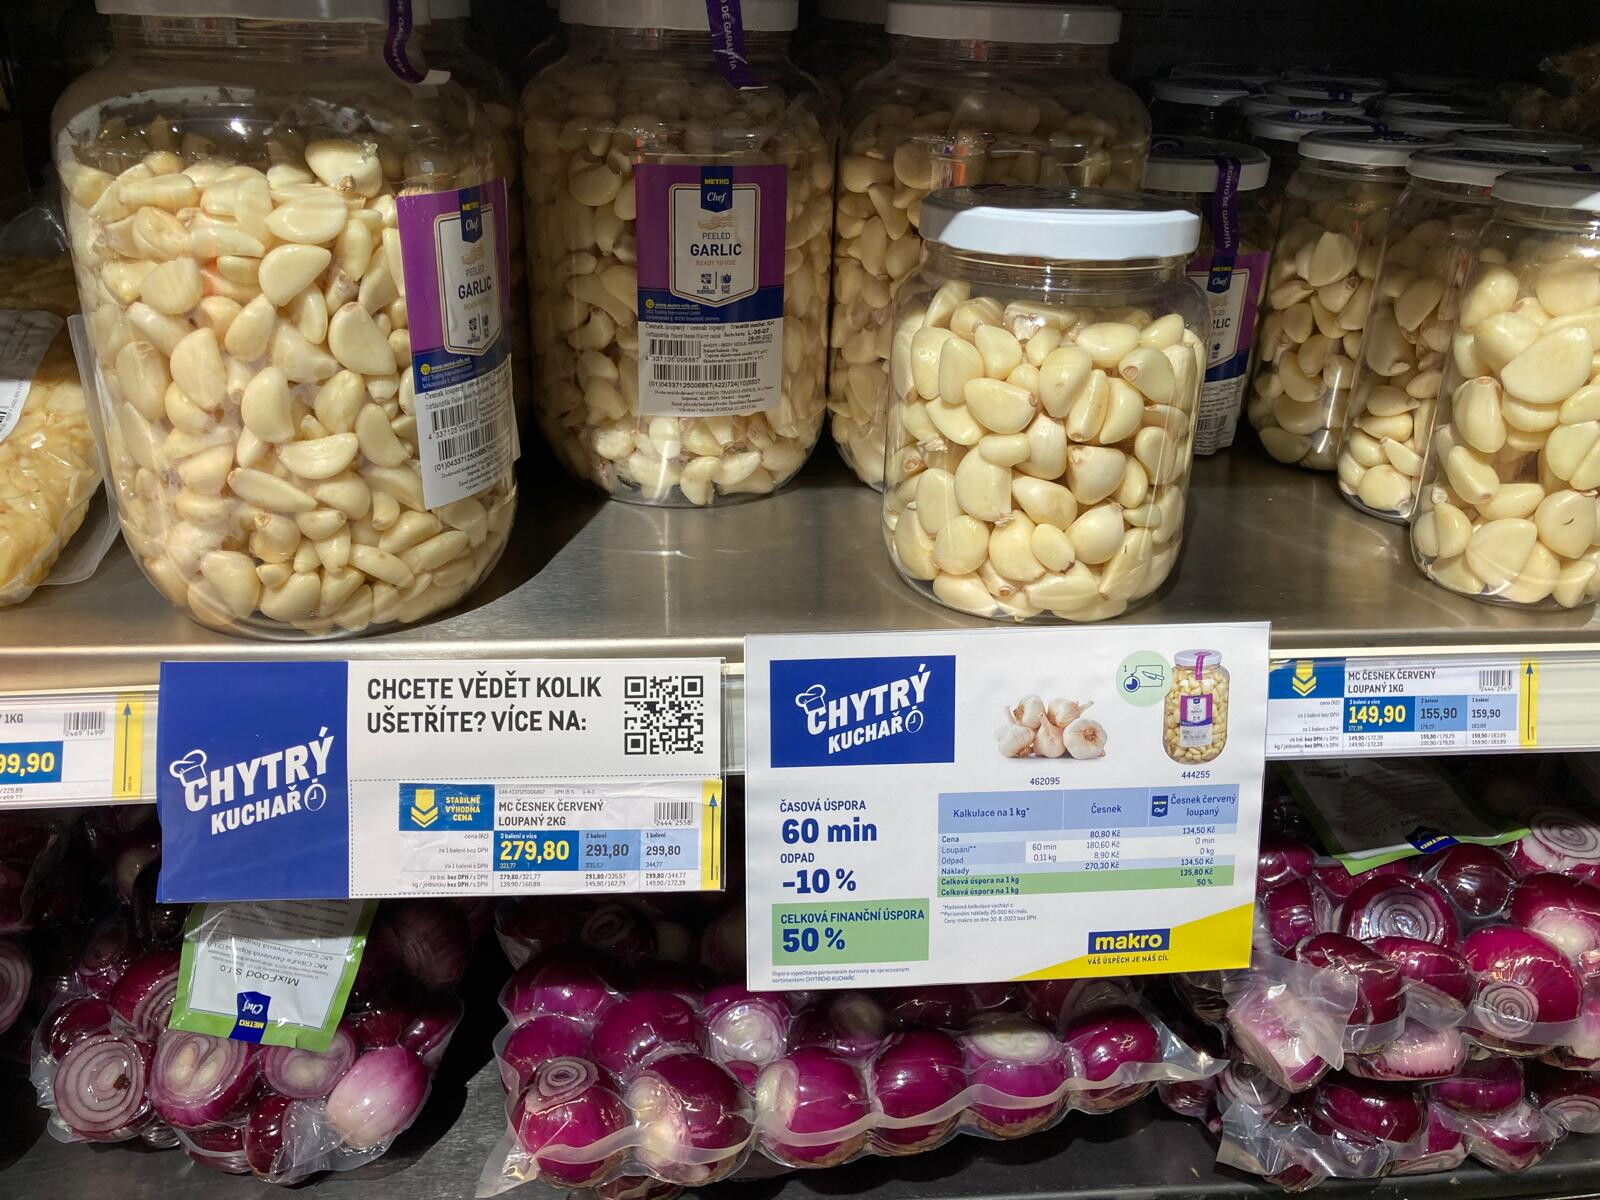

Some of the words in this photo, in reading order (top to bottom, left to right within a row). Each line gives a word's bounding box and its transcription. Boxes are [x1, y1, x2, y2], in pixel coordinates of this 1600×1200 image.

[707, 192, 727, 204] Chef
[690, 244, 742, 256] GARLIC
[458, 276, 491, 299] GARLIC
[1348, 671, 1361, 681] MC
[1362, 668, 1395, 680] ČESNEK
[1397, 668, 1436, 680] ČERVENÝ
[367, 678, 454, 700] CHCETE
[458, 670, 531, 699] VĚDĚT
[536, 676, 602, 698] KOLIK
[1348, 682, 1387, 693] LOUPANÝ
[1389, 684, 1404, 693] 1KG
[807, 663, 931, 735] CHYTRÝ
[5, 713, 23, 724] 1KG
[367, 704, 487, 734] UŠETŘÍTE?
[490, 703, 542, 732] VÍCE
[549, 710, 587, 732] NA:
[1349, 705, 1406, 726] 149,90
[1420, 707, 1458, 720] 155,90
[1472, 709, 1501, 719] 159,90
[828, 711, 903, 754] KUCHAŘ
[184, 726, 334, 812] CHYTRÝ
[1181, 771, 1210, 779] 444255
[1029, 777, 1060, 786] 462095
[446, 794, 481, 804] STABILNĚ
[499, 802, 513, 812] MC
[515, 798, 556, 811] ČESNEK
[557, 798, 604, 811] ČERVENÝ
[780, 798, 822, 813] ČASOVÁ
[824, 797, 866, 811] ÚSPORA
[1171, 794, 1200, 805] Česnek
[1202, 794, 1236, 804] červený
[211, 784, 302, 835] KUCHAŘ
[445, 803, 481, 813] VÝHODNÁ
[953, 809, 995, 818] Kalkulace
[997, 809, 1008, 817] na
[1009, 808, 1014, 816] 1
[1091, 802, 1122, 814] Česnek
[1186, 807, 1220, 817] loupaný
[498, 813, 545, 826] LOUPANÝ
[547, 816, 566, 826] 2KG
[782, 818, 819, 844] 60
[827, 816, 877, 842] min
[941, 835, 959, 843] Cena
[1090, 830, 1111, 838] 80,80
[1183, 827, 1206, 835] 134,50
[1207, 826, 1216, 834] Kč
[500, 840, 570, 864] 279,80
[586, 844, 629, 859] 291,80
[646, 845, 681, 857] 299,80
[1032, 843, 1042, 851] 60
[1087, 841, 1110, 849] 180,60
[1111, 840, 1120, 848] Kč
[780, 853, 815, 863] ODPAD
[941, 857, 964, 865] Odpad
[1033, 854, 1047, 862] 0,11
[1048, 854, 1057, 862] kg
[1111, 851, 1120, 859] Kč
[1206, 847, 1214, 856] kg
[941, 867, 970, 876] Náklady
[1085, 862, 1109, 870] 270,30
[1111, 861, 1120, 869] Kč
[1181, 858, 1204, 866] 134,50
[835, 868, 856, 891] %
[941, 877, 969, 886] Celková
[970, 877, 994, 886] úspora
[1011, 876, 1019, 885] kg
[1180, 869, 1203, 877] 135,80
[1205, 868, 1213, 876] Kč
[941, 888, 969, 896] Celková
[970, 888, 994, 896] úspora
[1011, 887, 1019, 895] kg
[781, 909, 828, 924] CELKOVÁ
[830, 908, 881, 922] FINANČNÍ
[883, 907, 925, 921] ÚSPORA
[783, 927, 819, 952] 50
[824, 927, 846, 950] %
[1095, 932, 1163, 950] makro
[1088, 956, 1101, 965] VÁŠ
[1103, 955, 1130, 964] ÚSPĚCH
[1142, 954, 1156, 962] NÁŠ
[1158, 954, 1169, 962] CÍL
[246, 969, 300, 987] MixFood
[239, 1019, 265, 1029] METRO
